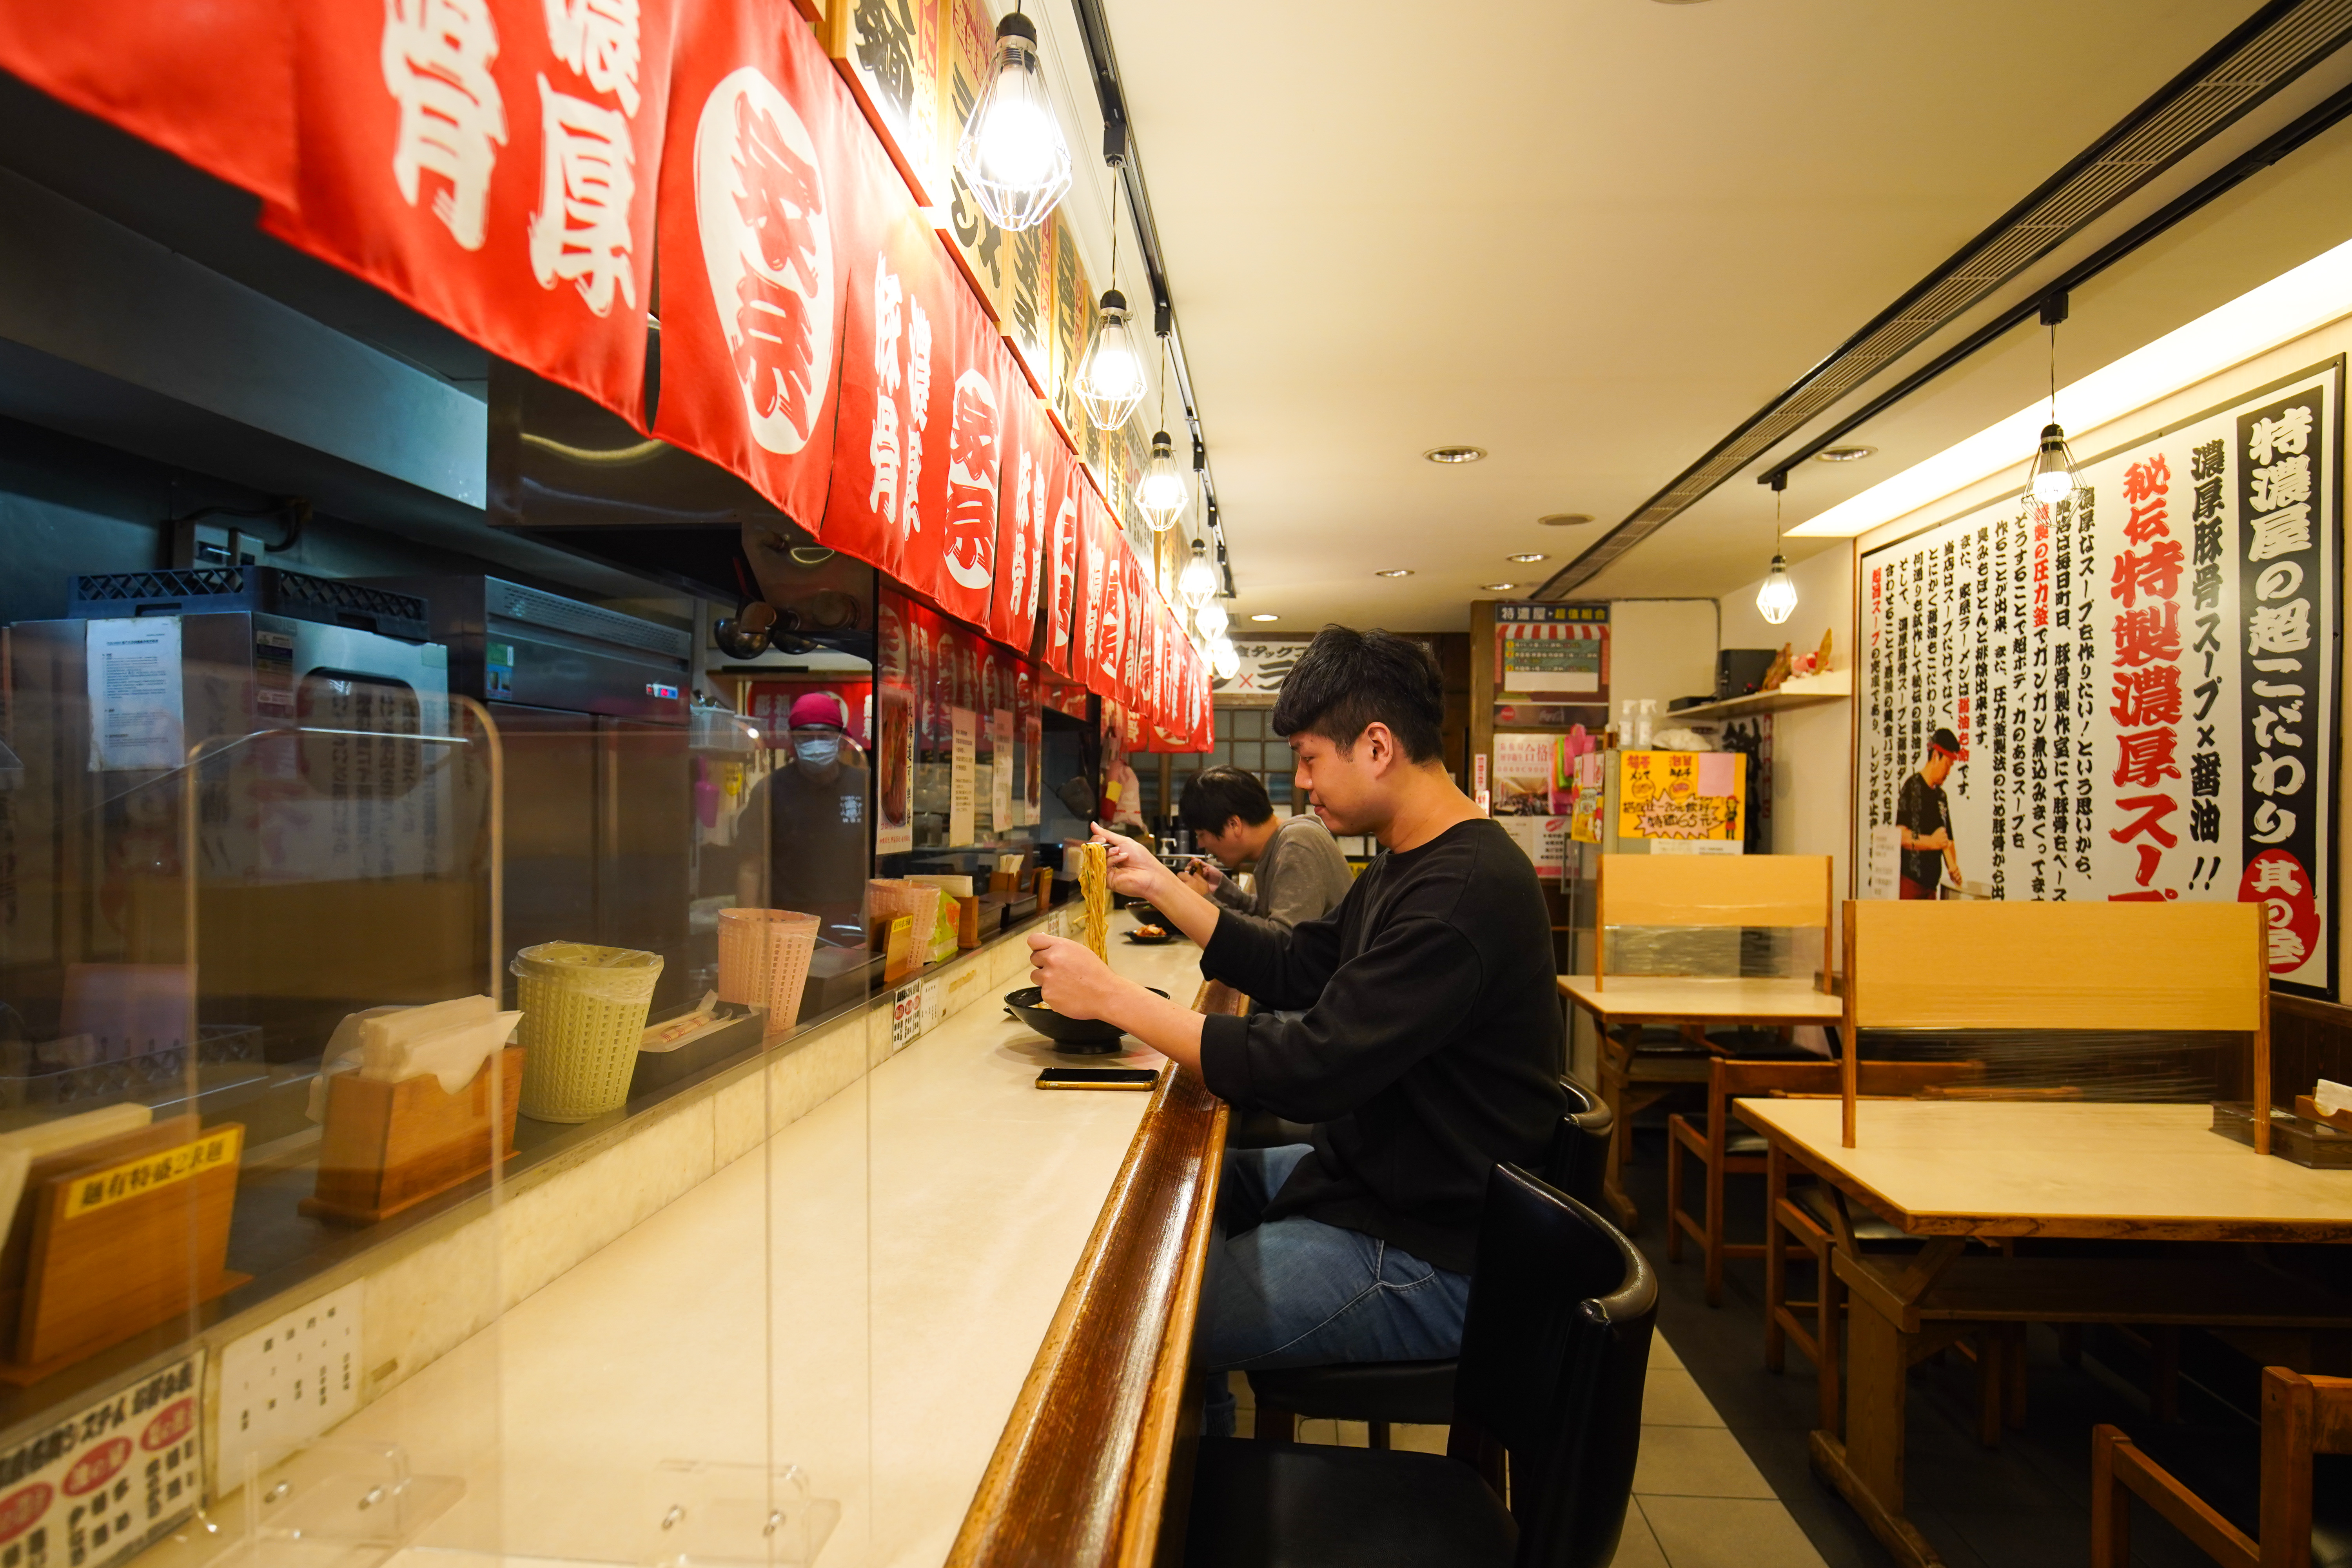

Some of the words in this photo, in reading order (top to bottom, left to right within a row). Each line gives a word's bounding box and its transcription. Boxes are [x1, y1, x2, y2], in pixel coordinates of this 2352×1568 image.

[2248, 405, 2313, 844] 特濃屋の超こだわり
